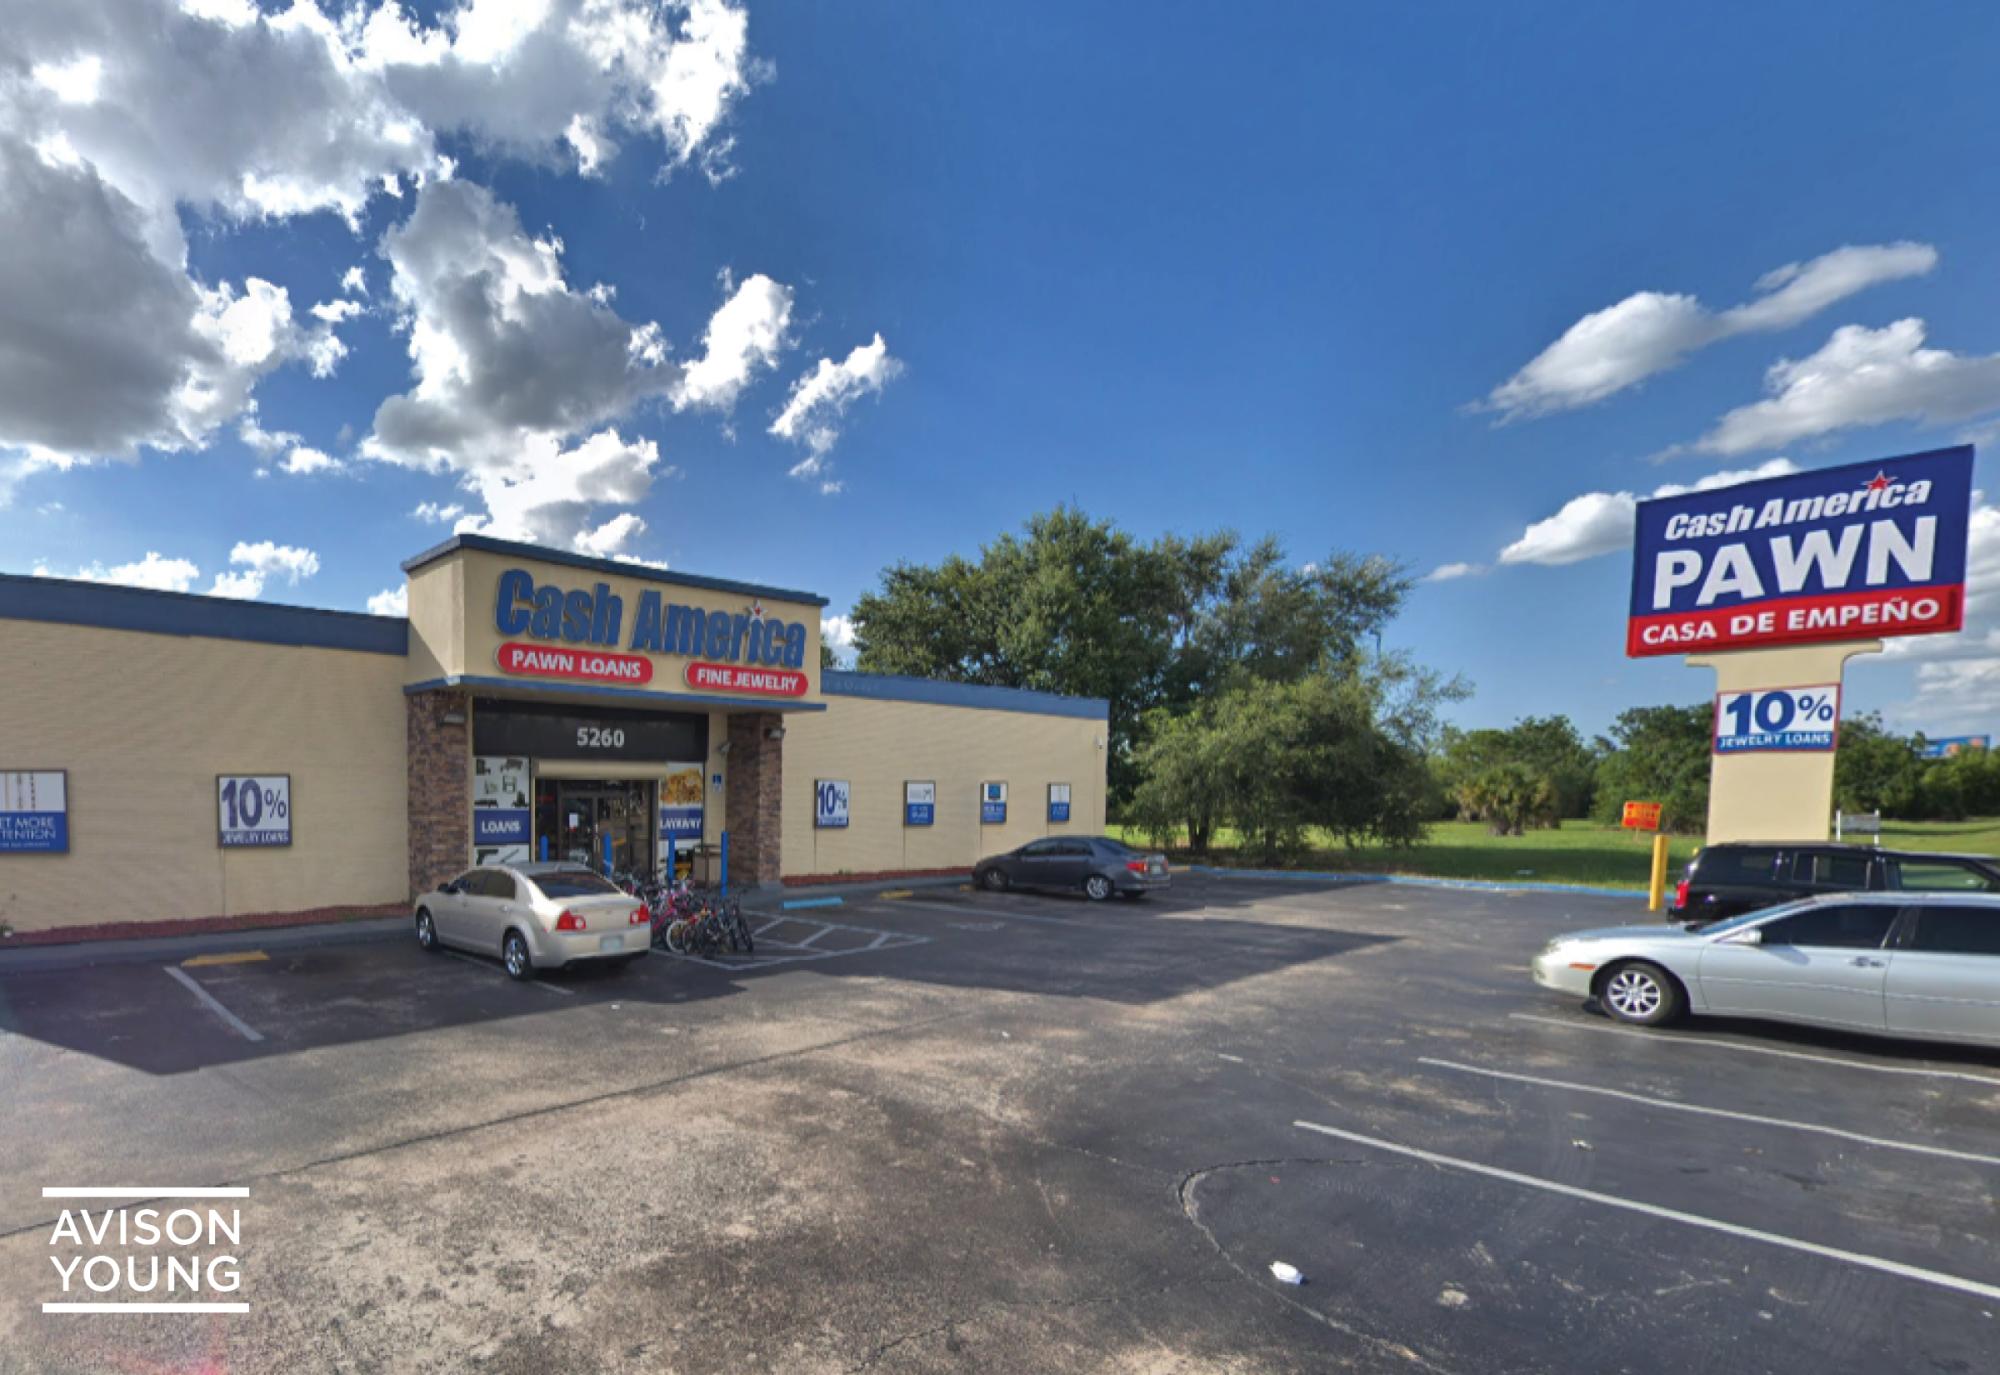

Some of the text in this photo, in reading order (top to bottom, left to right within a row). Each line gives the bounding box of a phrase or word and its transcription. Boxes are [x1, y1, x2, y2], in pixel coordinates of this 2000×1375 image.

[1664, 474, 1932, 541] Cash America
[1652, 515, 1939, 610] PAWN
[495, 568, 807, 669] Cash America
[1642, 597, 1940, 645] CASA DE EMPEÑO
[512, 648, 641, 678] PAWN LOANS
[697, 667, 799, 692] FINE JEWELRY
[1726, 690, 1833, 736] 10%
[577, 727, 625, 748] 5260
[1720, 731, 1831, 748] JEWELRY LOANS
[221, 779, 287, 828] 10%
[0, 829, 56, 840] TENTION
[481, 819, 521, 834] LOANS
